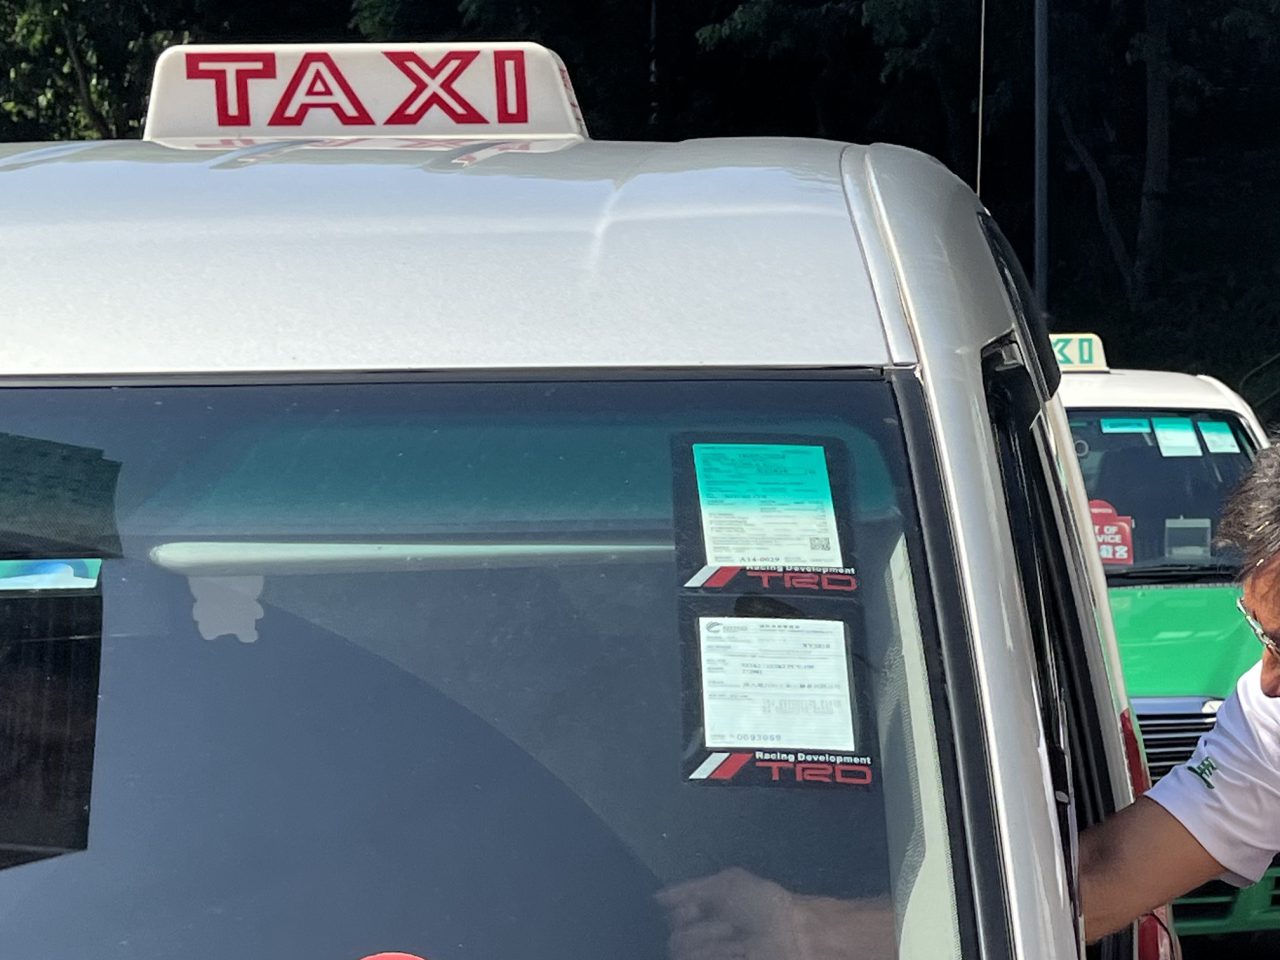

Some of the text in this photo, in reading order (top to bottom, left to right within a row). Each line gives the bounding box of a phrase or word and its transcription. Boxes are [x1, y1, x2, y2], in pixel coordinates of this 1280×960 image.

[186, 50, 529, 127] TAXI
[746, 571, 858, 592] TRD
[755, 751, 872, 765] Racing Development
[755, 761, 873, 785] TRD
